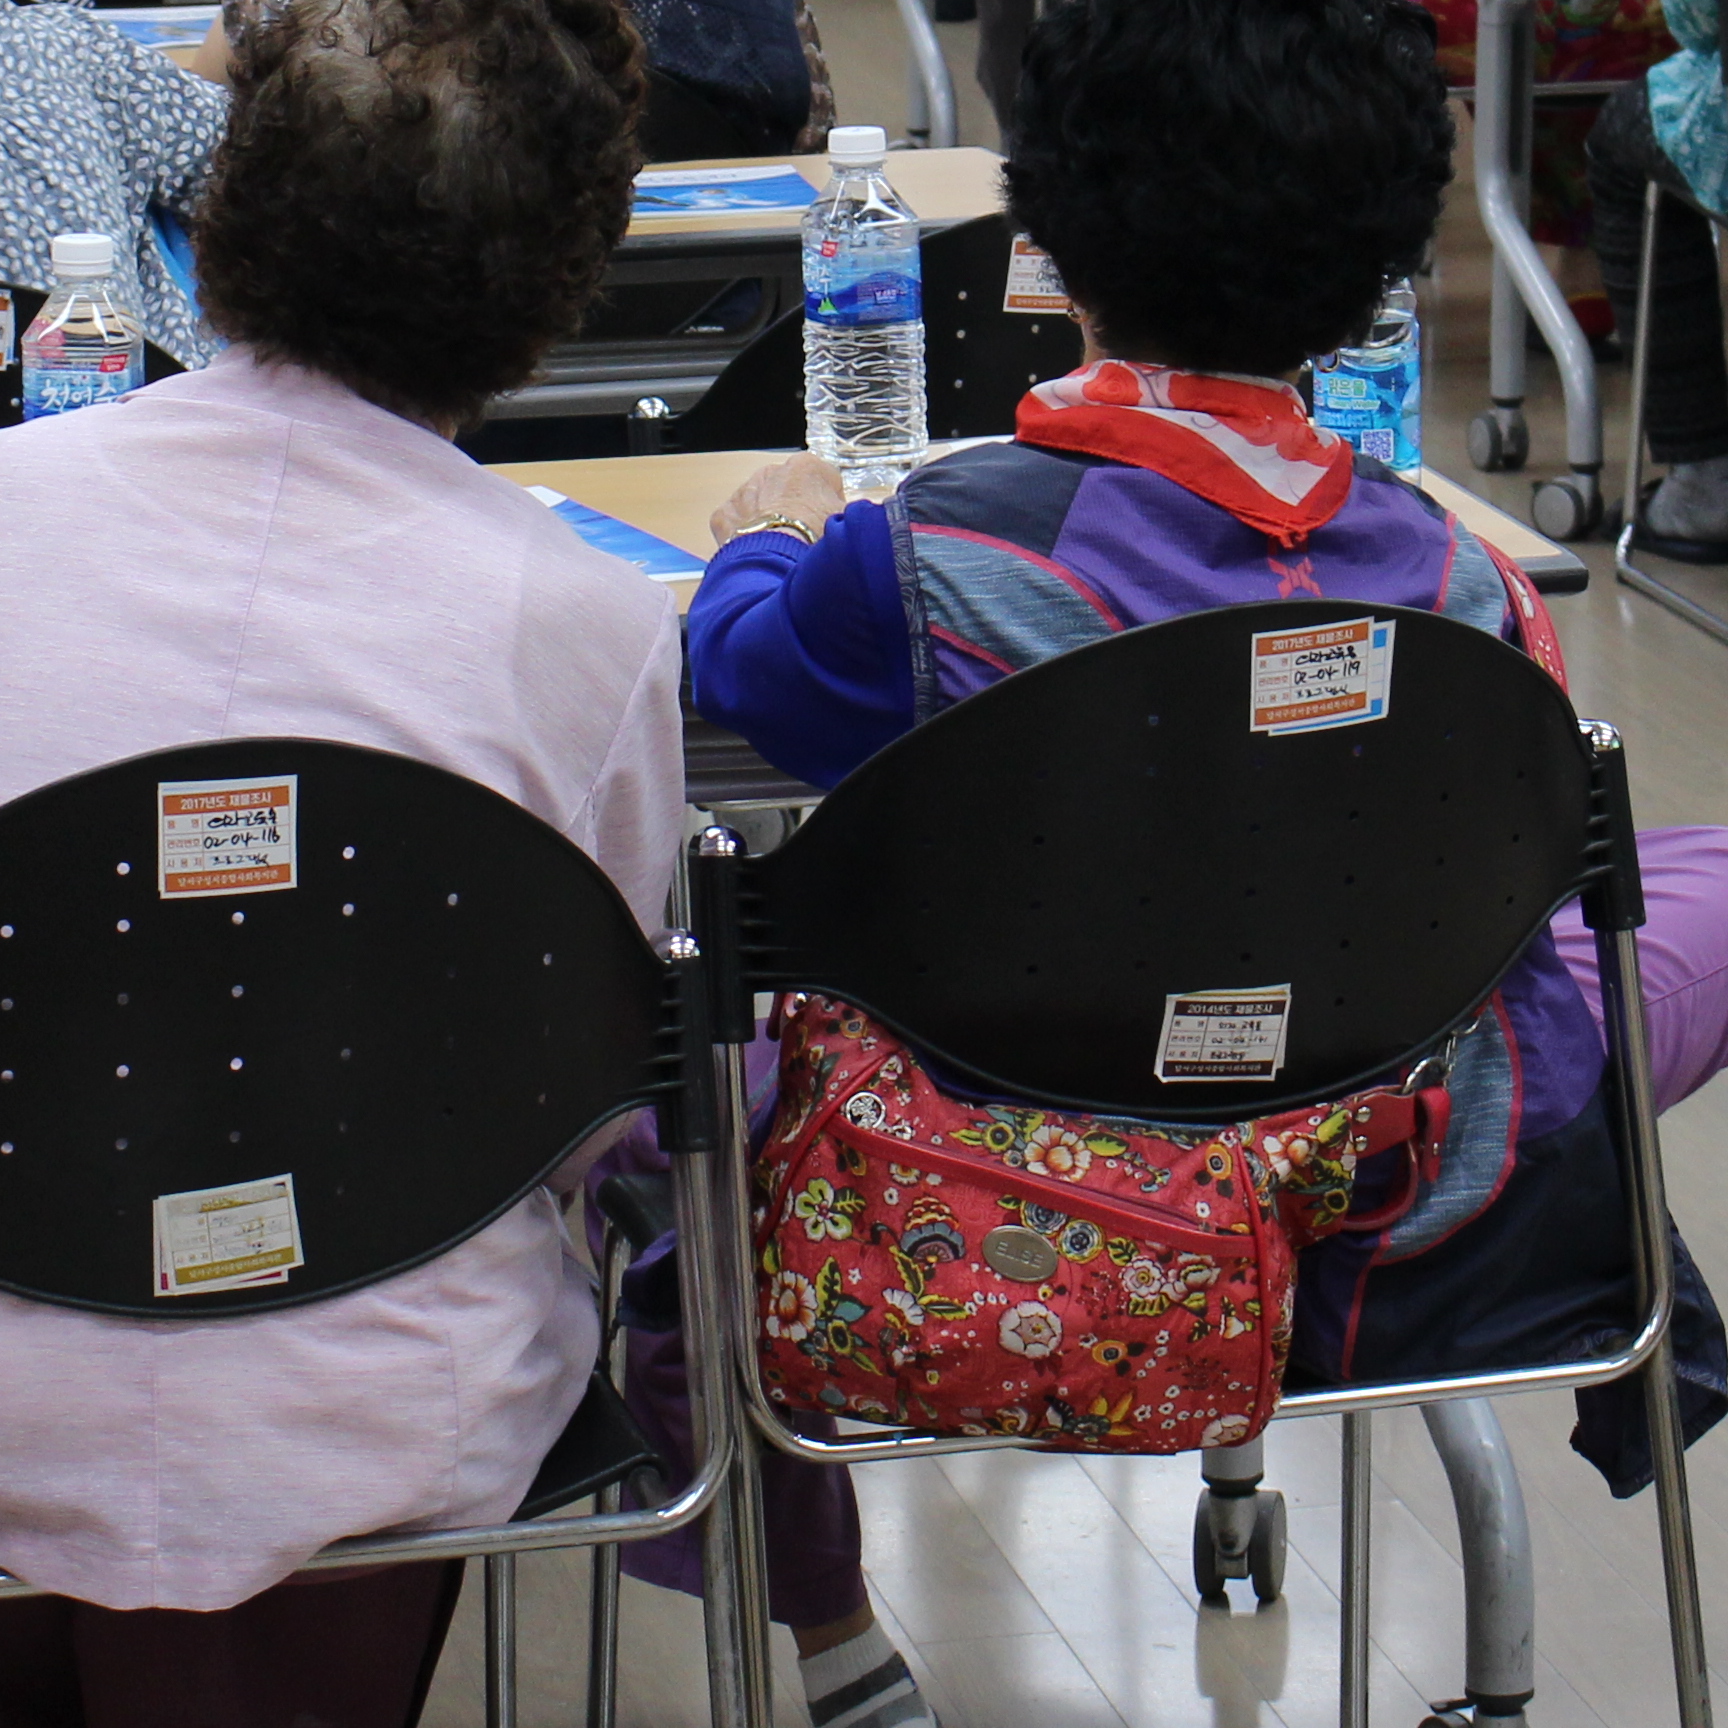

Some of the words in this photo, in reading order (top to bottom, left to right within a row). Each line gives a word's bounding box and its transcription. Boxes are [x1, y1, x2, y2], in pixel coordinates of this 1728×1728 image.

[1272, 636, 1313, 651] 2017년도
[180, 796, 226, 811] 2017년도
[229, 791, 272, 806] 재물조사
[1187, 1004, 1233, 1014] 2014년도
